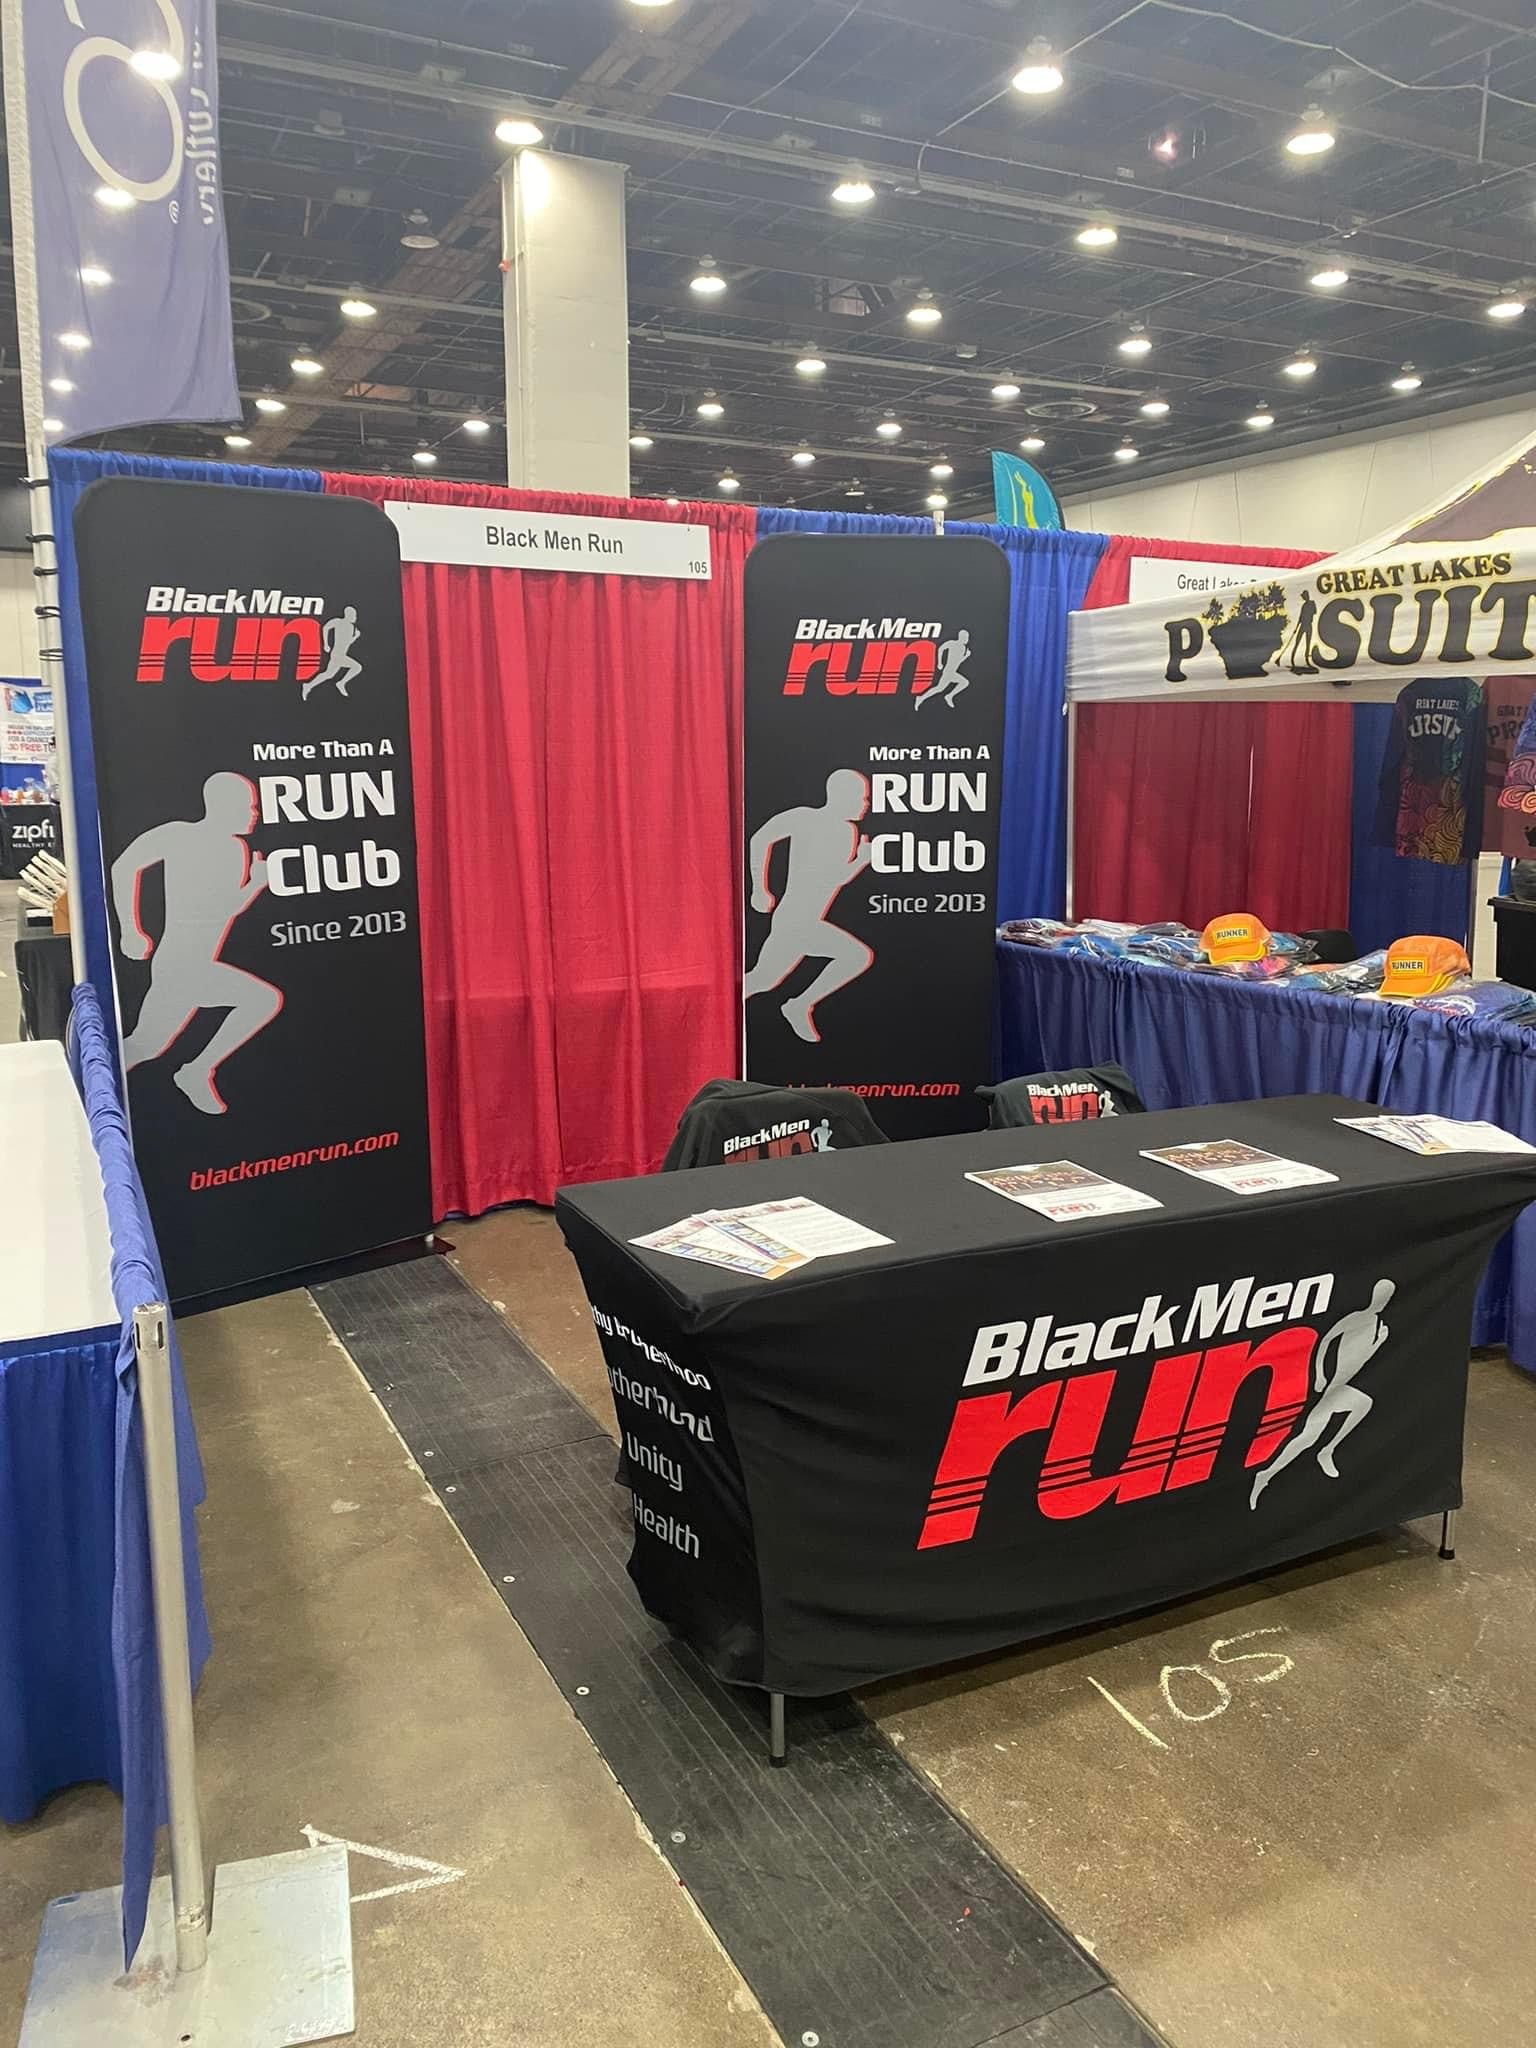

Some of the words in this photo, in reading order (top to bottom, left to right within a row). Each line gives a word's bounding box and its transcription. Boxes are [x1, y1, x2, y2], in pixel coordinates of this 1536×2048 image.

[486, 525, 538, 549] Black
[544, 529, 582, 552] Men
[588, 532, 624, 555] Run
[688, 560, 708, 575] 105
[1177, 573, 1209, 591] Great
[1316, 563, 1405, 595] GREAT
[1412, 552, 1512, 585] LAKES
[136, 615, 322, 683] run
[782, 640, 937, 696] run
[252, 742, 316, 761] More
[320, 740, 373, 759] Than
[378, 738, 394, 756] A
[869, 746, 922, 761] More
[926, 744, 972, 761] Than
[976, 744, 990, 760] A
[258, 769, 396, 825] RUN
[870, 771, 988, 814] RUN
[265, 839, 401, 897] Club
[870, 830, 987, 874] Club
[868, 893, 928, 914] Since
[934, 893, 987, 914] 2013
[270, 918, 343, 947] Since
[348, 909, 407, 939] 2013
[1216, 928, 1249, 939] RUNNER
[1391, 960, 1424, 970] RUNNER
[189, 1130, 400, 1192] blackmenrun.com
[916, 1325, 1319, 1551] run
[626, 1431, 684, 1493] Unity
[633, 1493, 700, 1559] Health
[1086, 1625, 1296, 1750] 105
